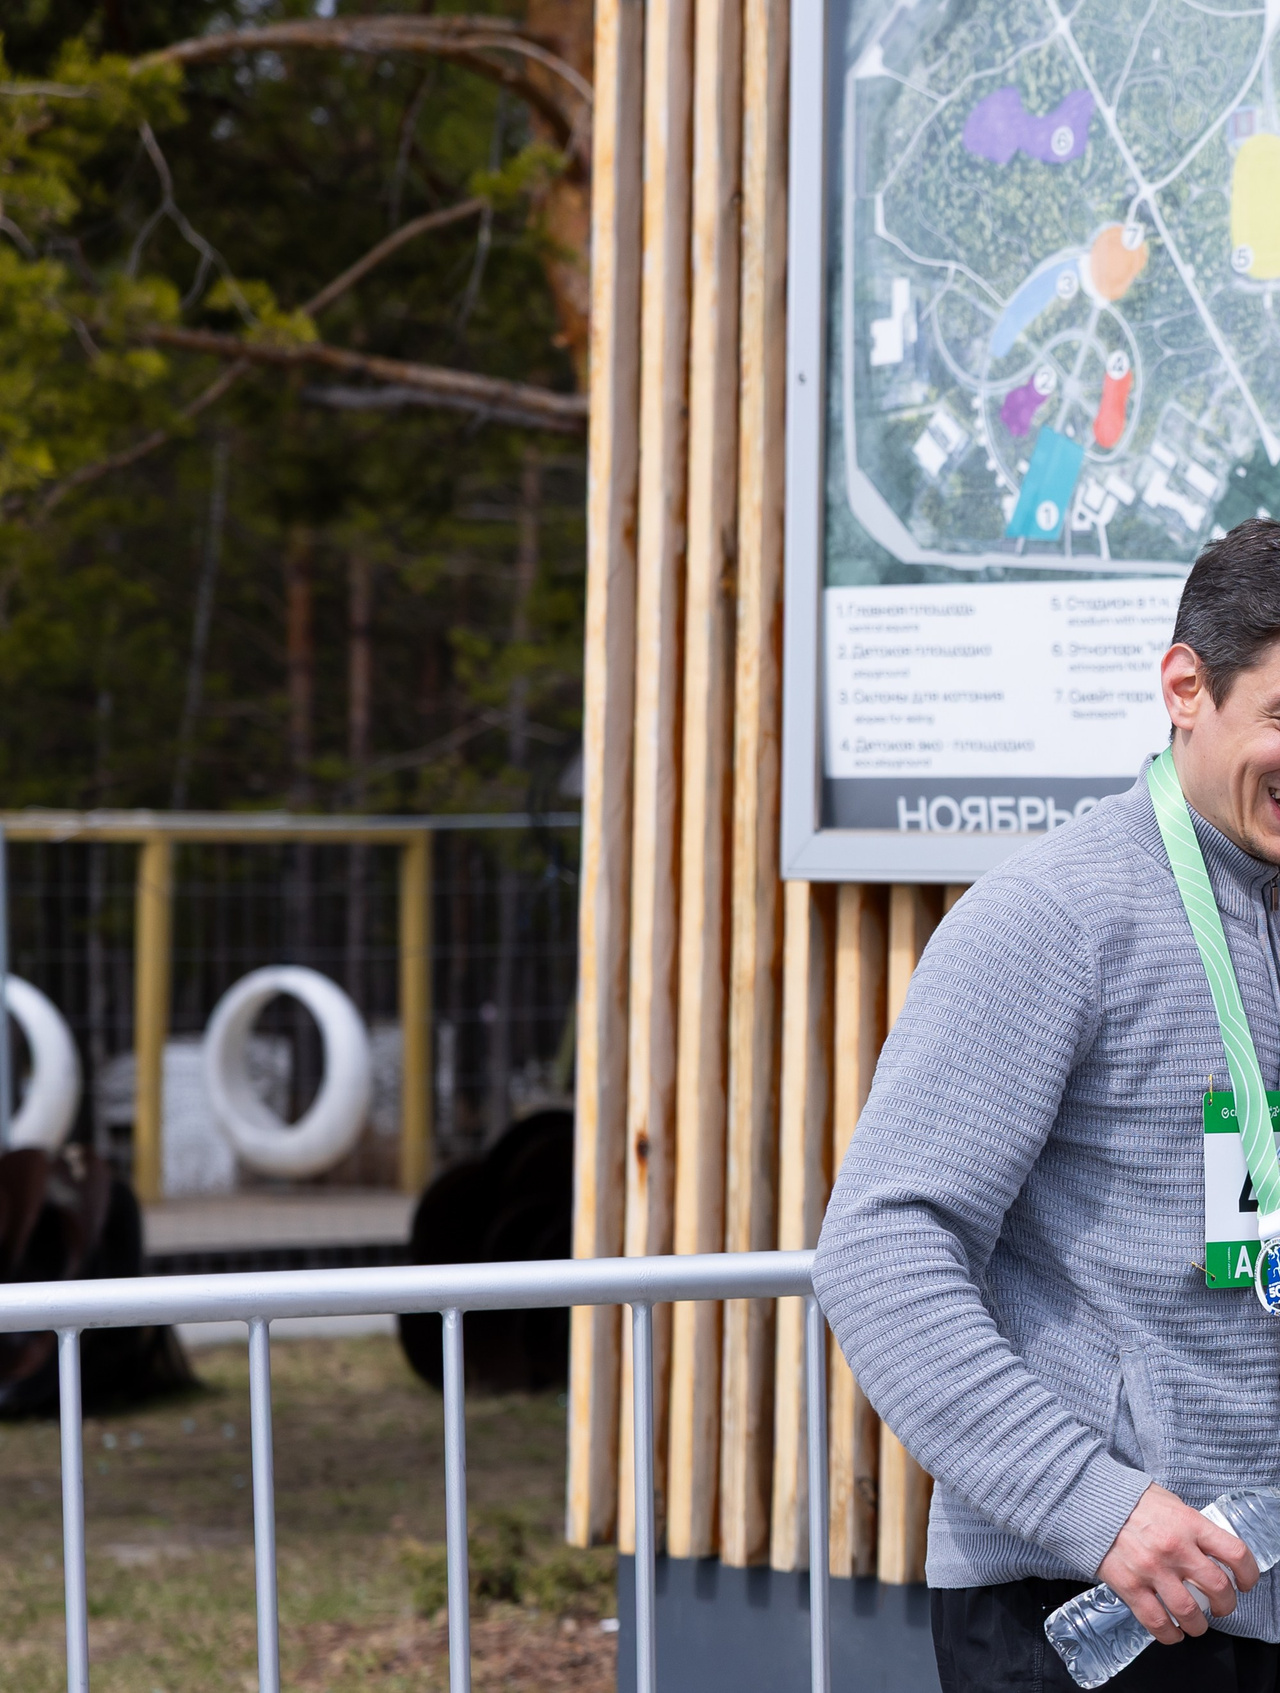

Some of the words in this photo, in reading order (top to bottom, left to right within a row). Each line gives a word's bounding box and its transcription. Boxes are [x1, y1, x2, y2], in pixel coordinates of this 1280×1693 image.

[1126, 227, 1139, 247] 7
[1236, 247, 1250, 269] 5
[1060, 275, 1074, 295] 3
[1044, 507, 1052, 525] 1
